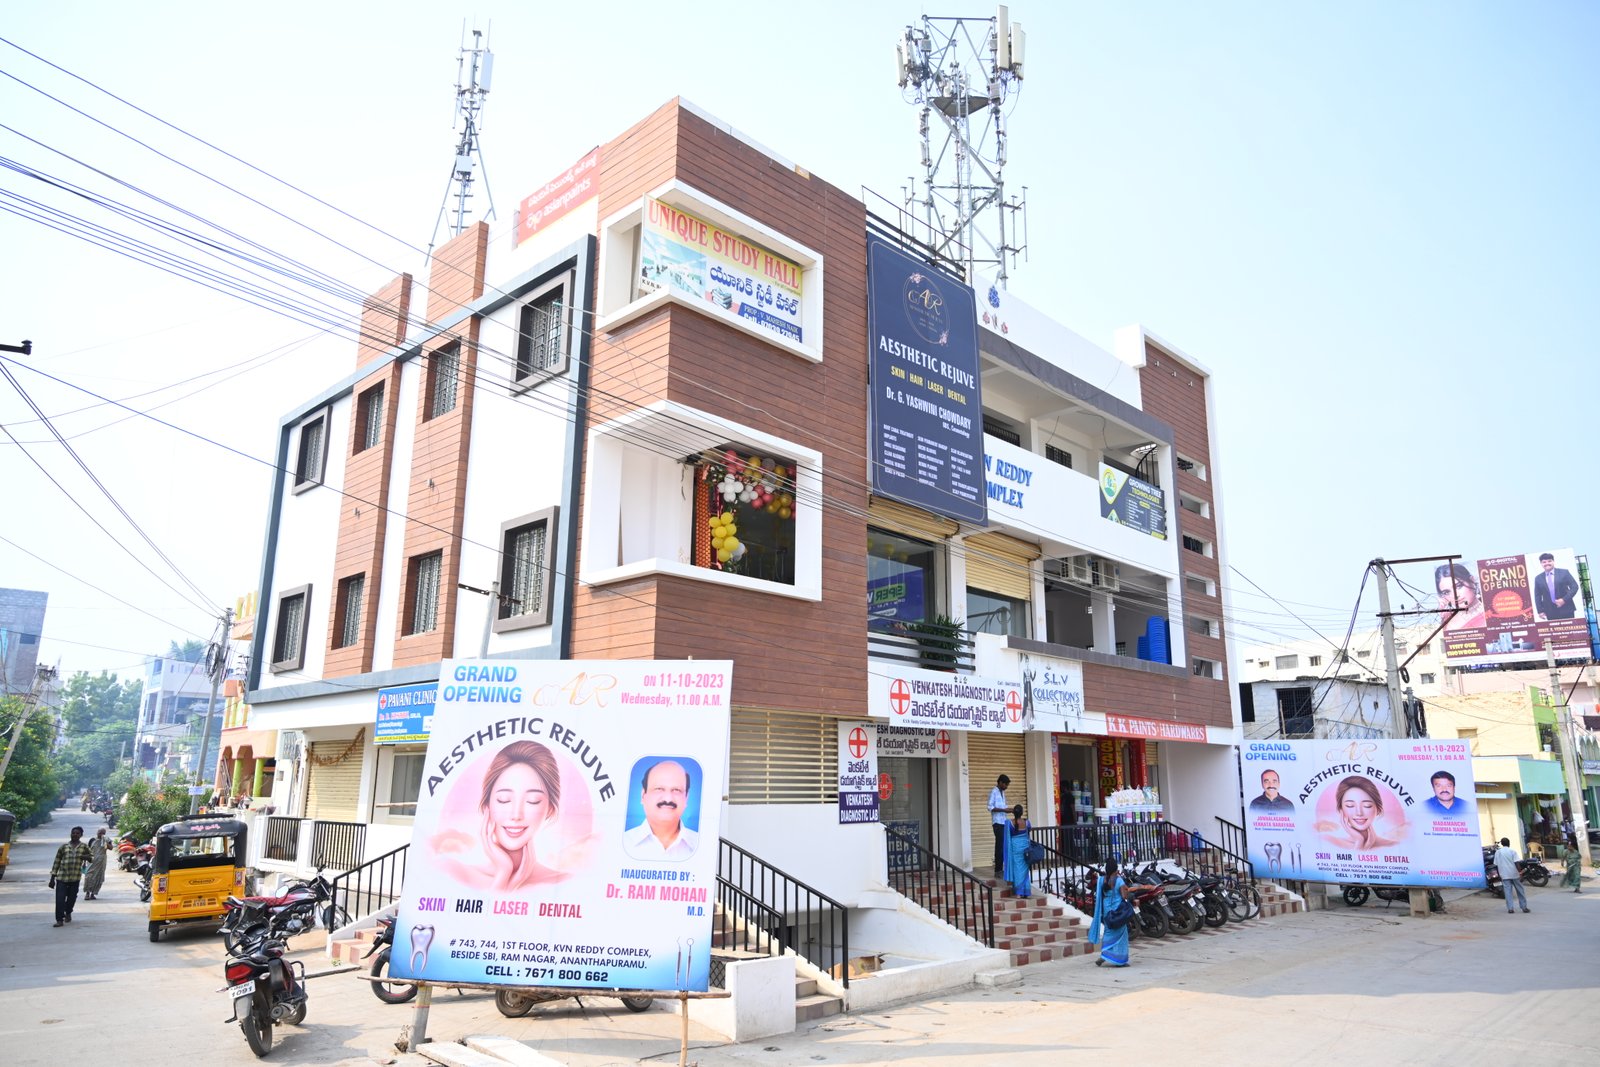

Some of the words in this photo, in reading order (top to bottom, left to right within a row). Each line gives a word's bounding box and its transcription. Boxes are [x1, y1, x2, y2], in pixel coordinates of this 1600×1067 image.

[648, 200, 709, 247] UNIQUE
[712, 230, 760, 271] STUDY
[764, 254, 800, 289] HALL
[776, 293, 799, 316] హాల్
[880, 335, 939, 373] AESTHETIC
[940, 361, 975, 390] REJUVE
[891, 366, 905, 379] SKIN
[910, 373, 924, 386] HAIR
[927, 380, 944, 395] LASER
[947, 389, 967, 406] DENTAL
[886, 386, 896, 400] Dr.
[897, 391, 905, 404] G.
[905, 393, 938, 417] YASHWINI
[938, 406, 972, 430] CHOWDARY
[995, 458, 1033, 487] REDDY
[1480, 564, 1526, 583] GRAND
[1483, 578, 1527, 592] OPENING
[453, 665, 518, 683] GRAND
[644, 675, 656, 687] ON
[659, 673, 724, 689] 11-10-2023
[387, 692, 412, 708] PAVANI
[442, 685, 523, 704] OPENING
[620, 691, 673, 707] Wednesday,
[676, 693, 700, 706] 11.00
[703, 694, 723, 706] A.M.
[911, 680, 953, 698] VENKATESH
[954, 685, 992, 701] DIAGNOSTIC
[993, 689, 1005, 703] LAB
[889, 726, 923, 736] DIAGNOSTIC
[925, 728, 936, 737] LAB
[1107, 717, 1117, 732] K
[1129, 719, 1157, 736] PAINTS
[1159, 723, 1205, 741] HARDWARES
[1245, 752, 1297, 761] OPENING
[1249, 743, 1290, 751] GRAND
[1423, 744, 1465, 752] 11-10-2023
[427, 717, 544, 797] AESTHETIC
[549, 722, 616, 803] REJUVE
[1298, 763, 1362, 805] AESTHETIC
[1366, 766, 1415, 807] REJUVE
[845, 793, 873, 806] VENKATESH
[841, 809, 869, 822] DIAGNOSTIC
[869, 809, 879, 821] LAB
[1315, 852, 1331, 860] SKIN
[1336, 853, 1352, 861] HAIR
[1358, 854, 1378, 862] LASER
[1384, 855, 1410, 863] DENTAL
[620, 868, 678, 881] INAUGURATED
[679, 871, 691, 881] BY
[605, 883, 623, 899] Dr.
[627, 884, 657, 901] RAM
[659, 886, 707, 903] MOHAN
[418, 897, 446, 912] SKIN
[455, 899, 483, 914] HAIR
[493, 900, 529, 916] LASER
[539, 903, 582, 919] DENTAL
[687, 905, 706, 917] M.D.
[449, 939, 456, 947] #
[458, 939, 477, 949] 743,
[480, 940, 498, 950] 744,
[502, 941, 516, 950] 1ST
[518, 942, 551, 953] FLOOR,
[553, 943, 573, 953] KVN
[575, 945, 605, 955] REDDY
[607, 946, 652, 958] COMPLEX,
[451, 950, 480, 960] BESIDE
[482, 951, 498, 961] SBI,
[501, 952, 520, 962] RAM
[523, 954, 557, 965] NAGAR,
[560, 956, 647, 969] ANANTHAPURAMU.
[485, 965, 513, 976] CELL
[524, 967, 554, 979] 7671
[558, 969, 582, 981] 800
[585, 970, 609, 982] 662
